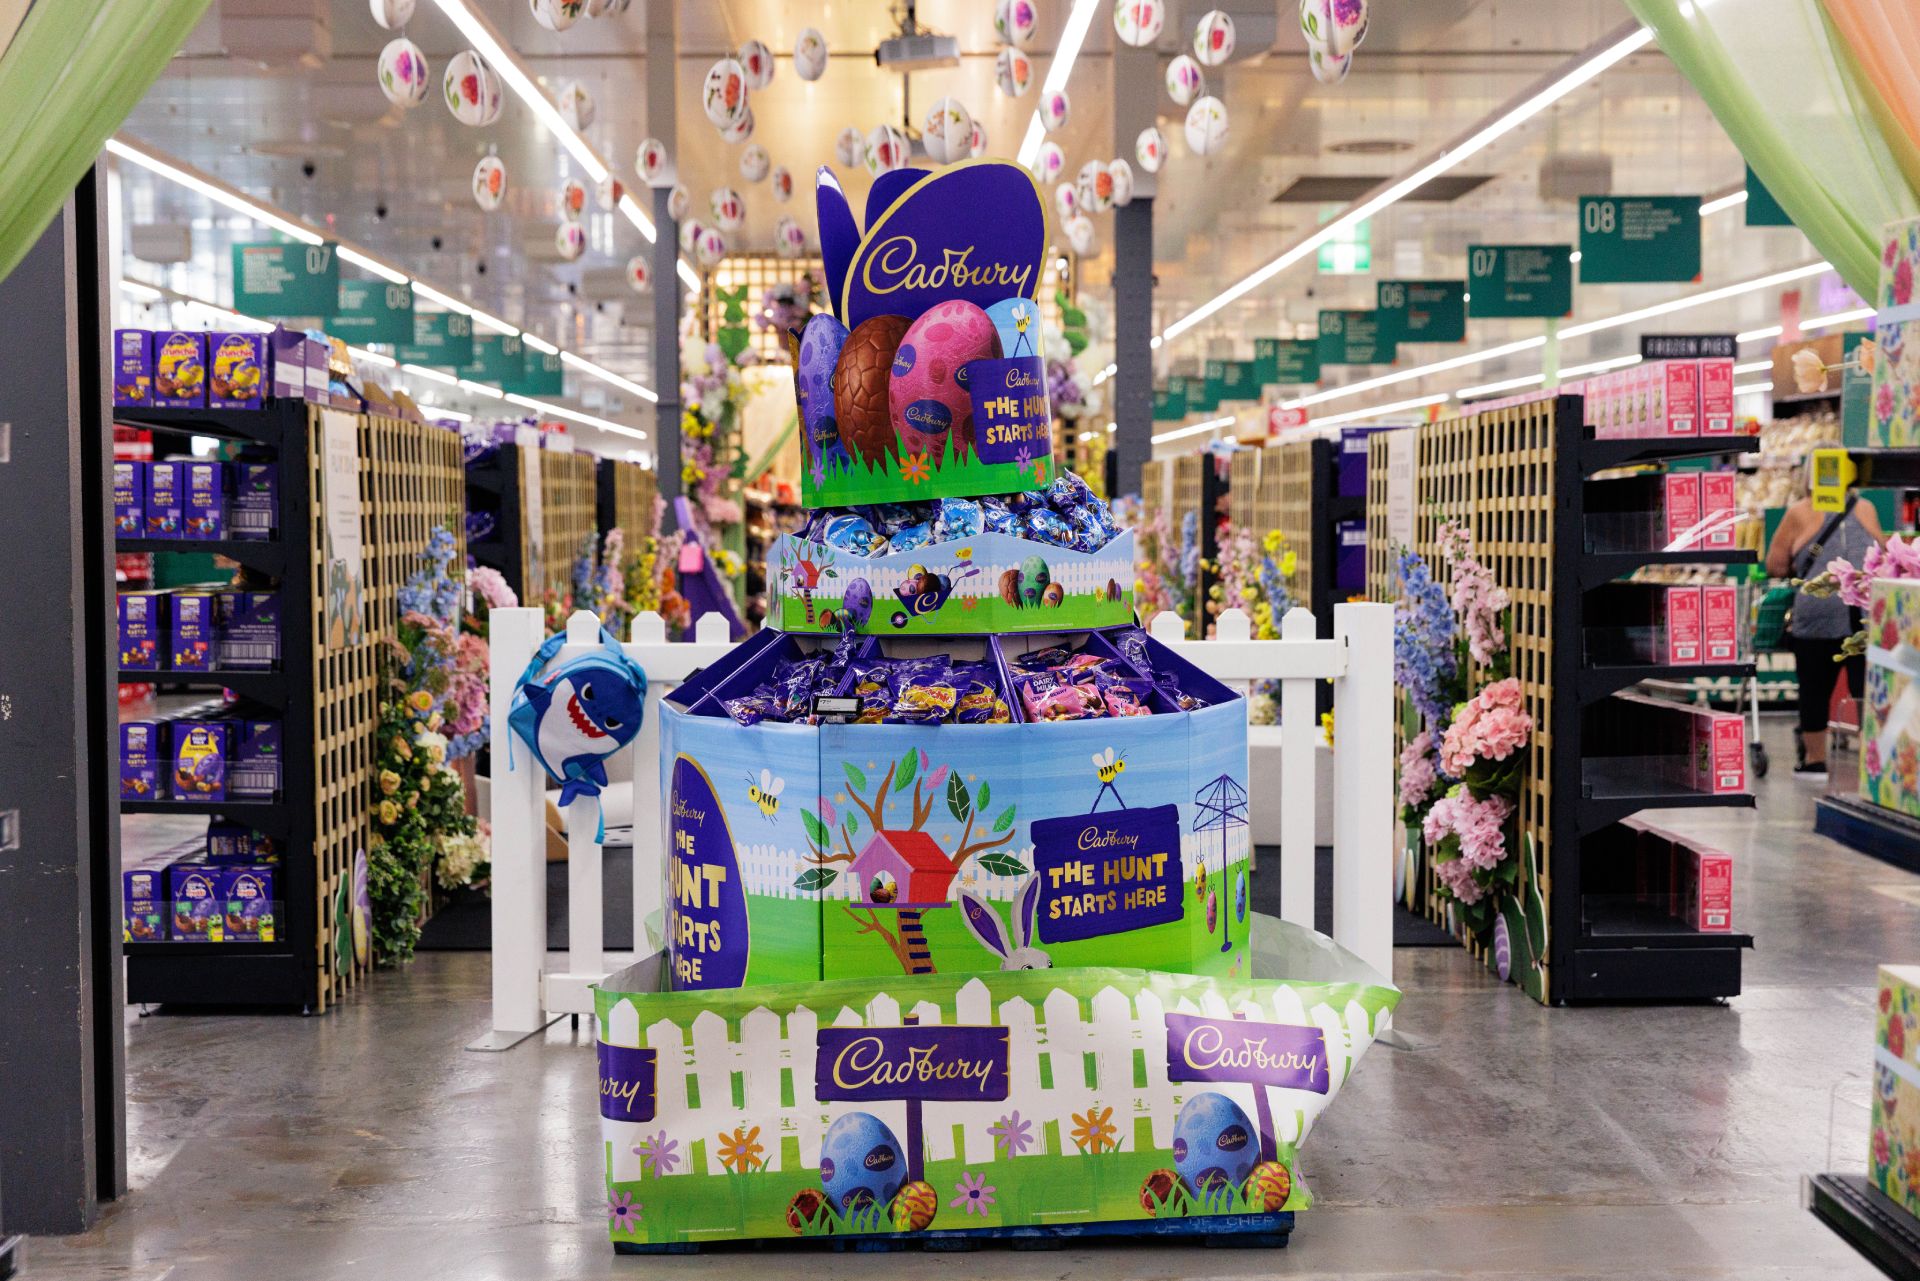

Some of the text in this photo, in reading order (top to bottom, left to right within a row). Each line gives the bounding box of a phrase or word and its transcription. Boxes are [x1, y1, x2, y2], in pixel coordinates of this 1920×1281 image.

[1584, 201, 1616, 233] 08
[305, 246, 331, 274] 07
[863, 235, 1032, 298] Cadbury
[1473, 249, 1498, 277] 07
[1380, 284, 1405, 307] 06
[1646, 337, 1732, 357] FROZEN PIES
[1005, 368, 1039, 389] Cadbury
[906, 406, 948, 429] Cadbury
[983, 395, 1049, 419] THE HUN
[986, 423, 1033, 445] STARTS
[1033, 677, 1054, 687] DAIRY
[672, 789, 706, 827] Cadbury
[675, 829, 695, 855] THE
[1078, 826, 1138, 850] Cadbury
[670, 855, 726, 909] HUNT
[1048, 853, 1168, 888] THE HUNT
[1049, 885, 1167, 920] STARTS HERE
[672, 911, 722, 954] STARTS
[675, 953, 702, 983] HERE
[833, 1036, 994, 1092] Cadbury
[1183, 1025, 1317, 1082] Cadbury
[865, 1154, 894, 1167] Cadbury
